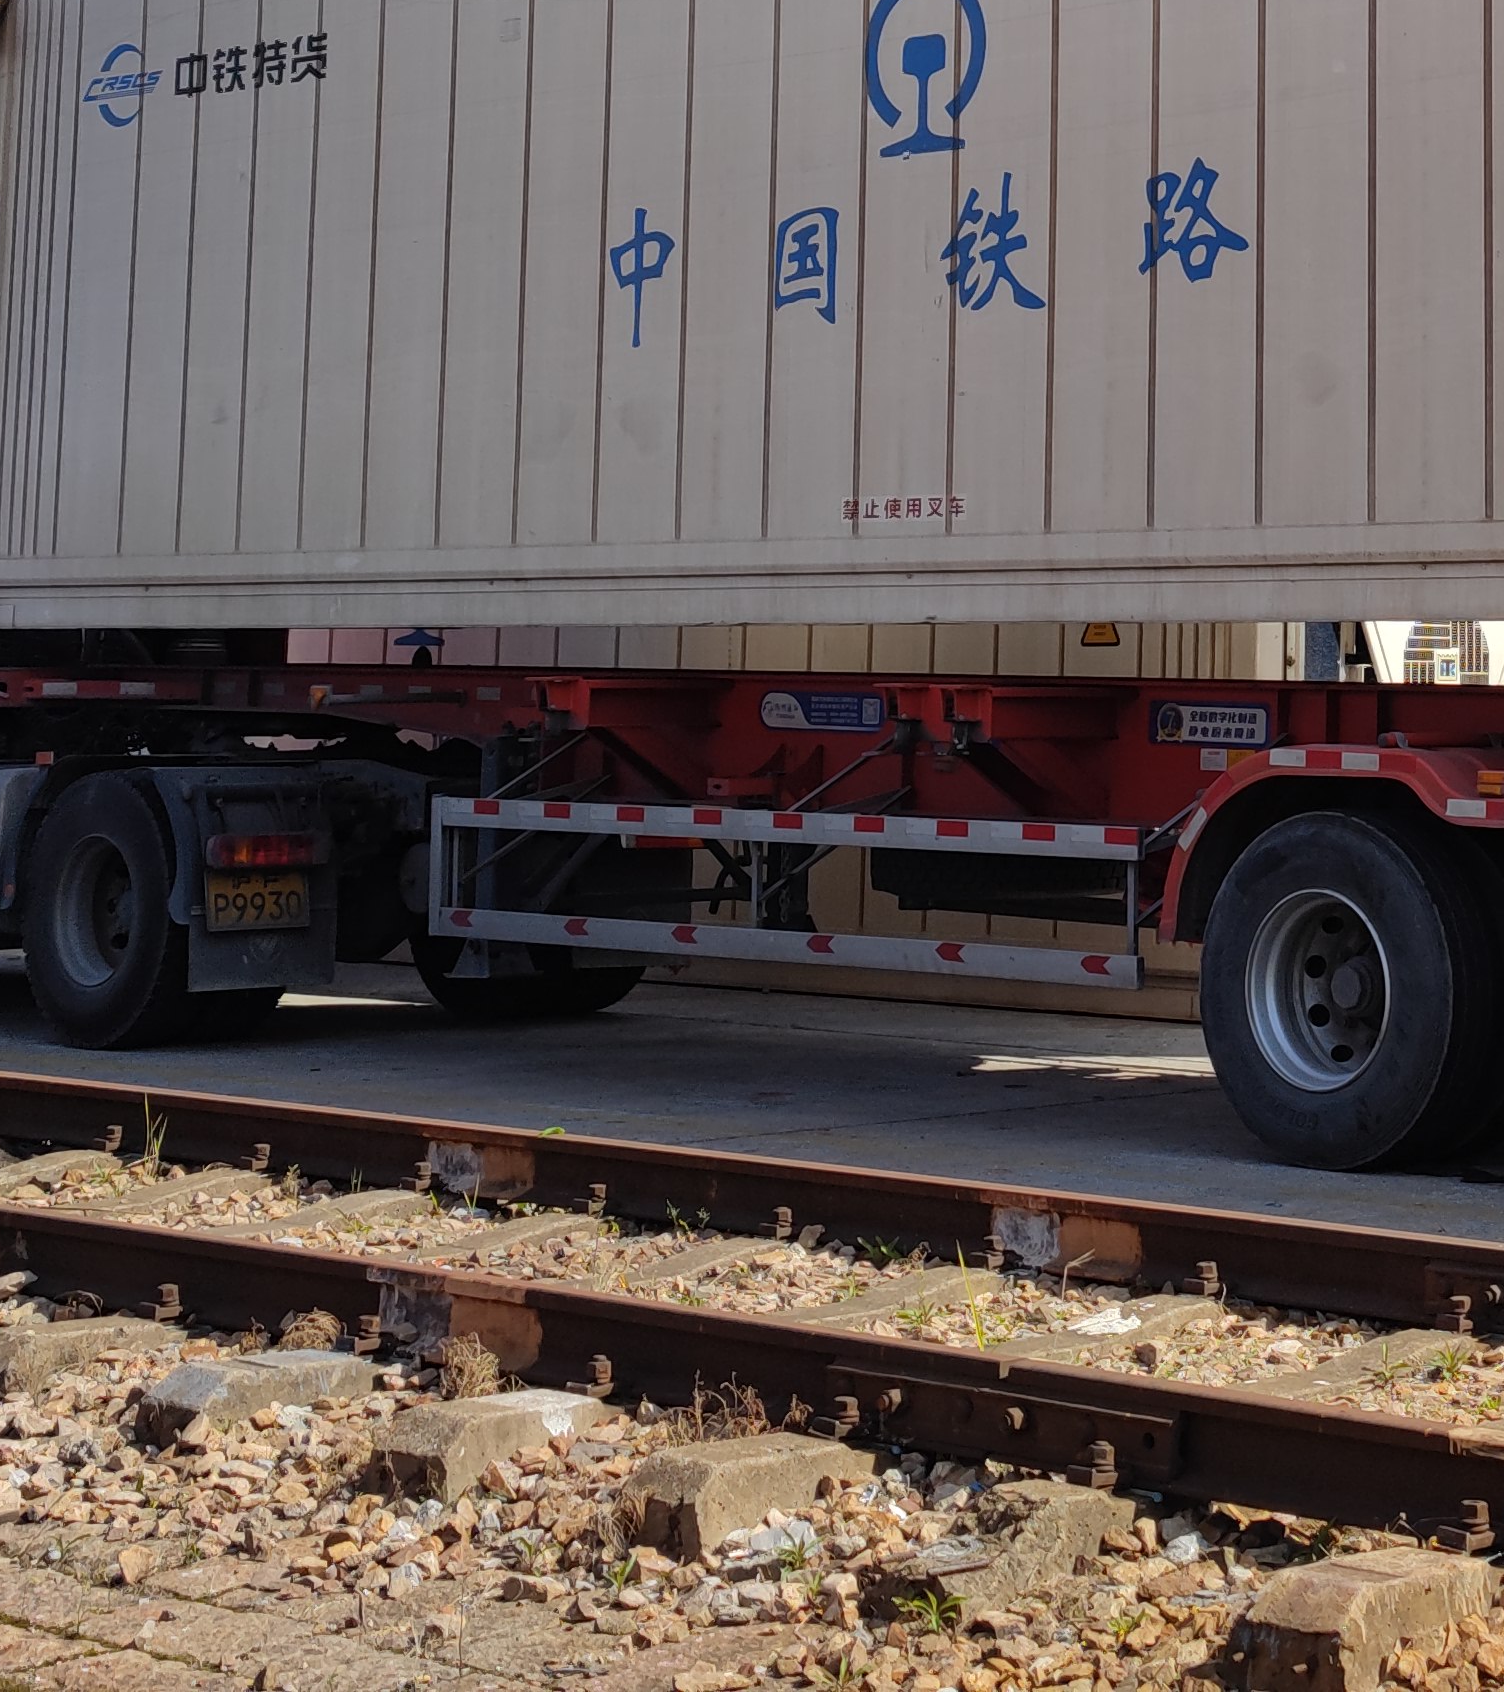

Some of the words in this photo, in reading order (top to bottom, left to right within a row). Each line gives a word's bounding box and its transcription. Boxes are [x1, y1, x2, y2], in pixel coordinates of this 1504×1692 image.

[174, 32, 328, 98] 中铁特货
[82, 69, 163, 102] CRSCS
[608, 157, 1249, 349] 中国铁路
[842, 496, 965, 520] 禁止使用叉车
[214, 890, 302, 924] P9930
